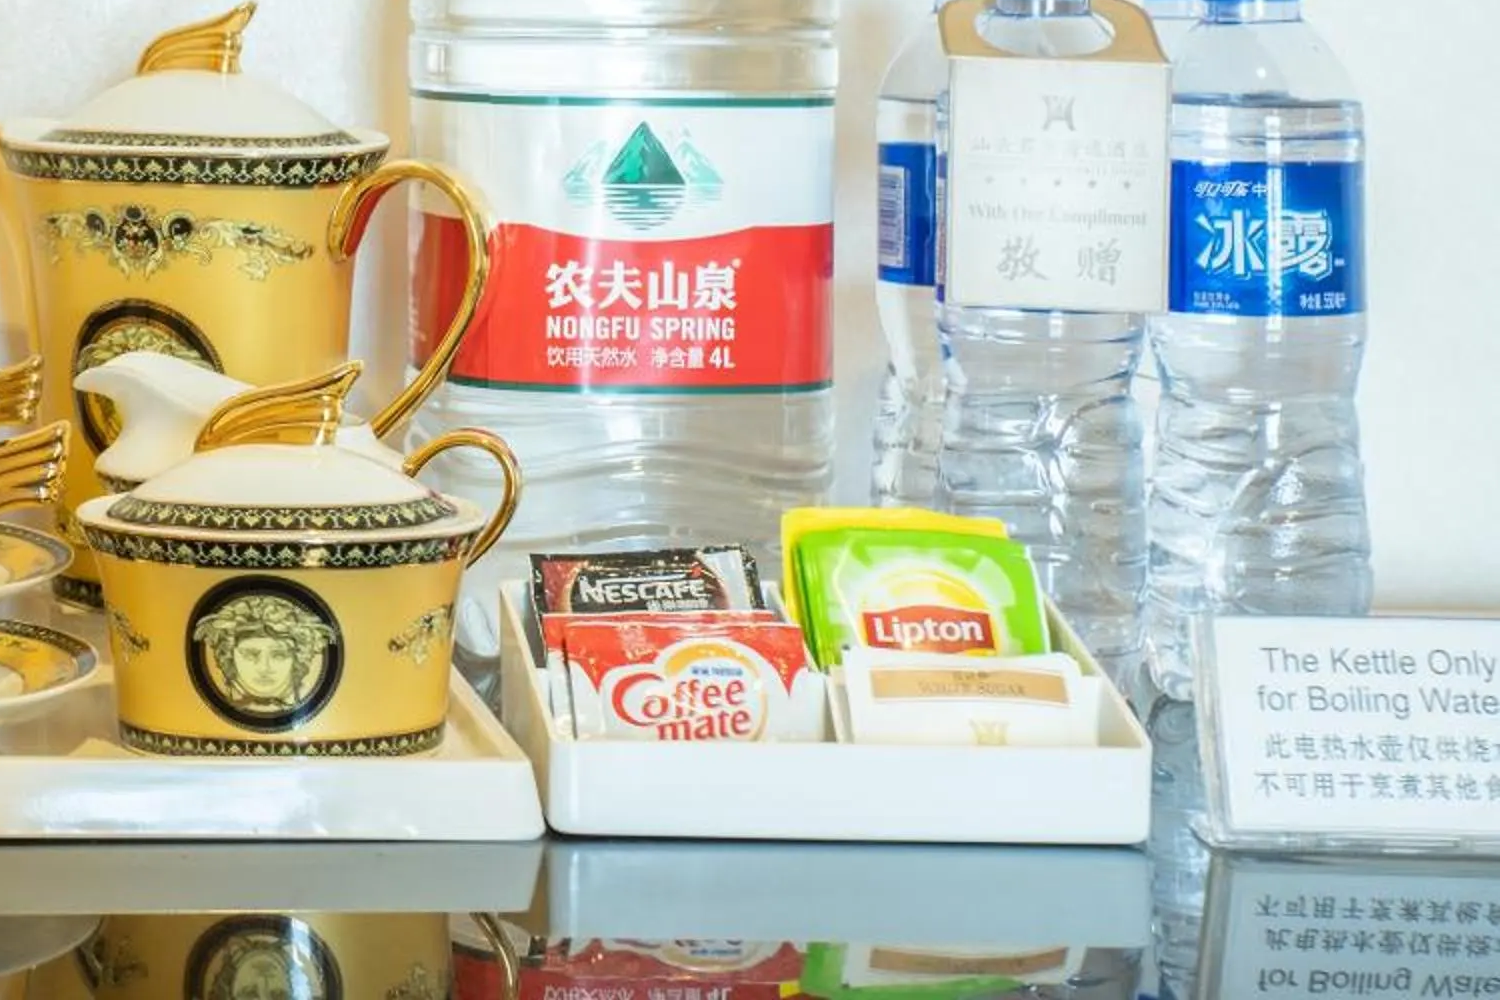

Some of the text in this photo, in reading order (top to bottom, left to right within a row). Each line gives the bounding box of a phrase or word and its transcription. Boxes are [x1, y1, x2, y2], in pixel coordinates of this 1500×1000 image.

[968, 202, 1148, 229] With Our Compliment
[1194, 207, 1333, 281] 冰露
[545, 260, 737, 310] 农夫山泉
[546, 316, 736, 341] NONGFU SPRING
[547, 345, 736, 369] 饮用天然水 净含量 4L
[873, 616, 984, 652] Lipton
[1261, 647, 1497, 683] The Kettle Only
[612, 671, 746, 728] Coffee
[1257, 684, 1297, 711] for
[1307, 685, 1410, 719] Boiling
[657, 709, 751, 741] mate
